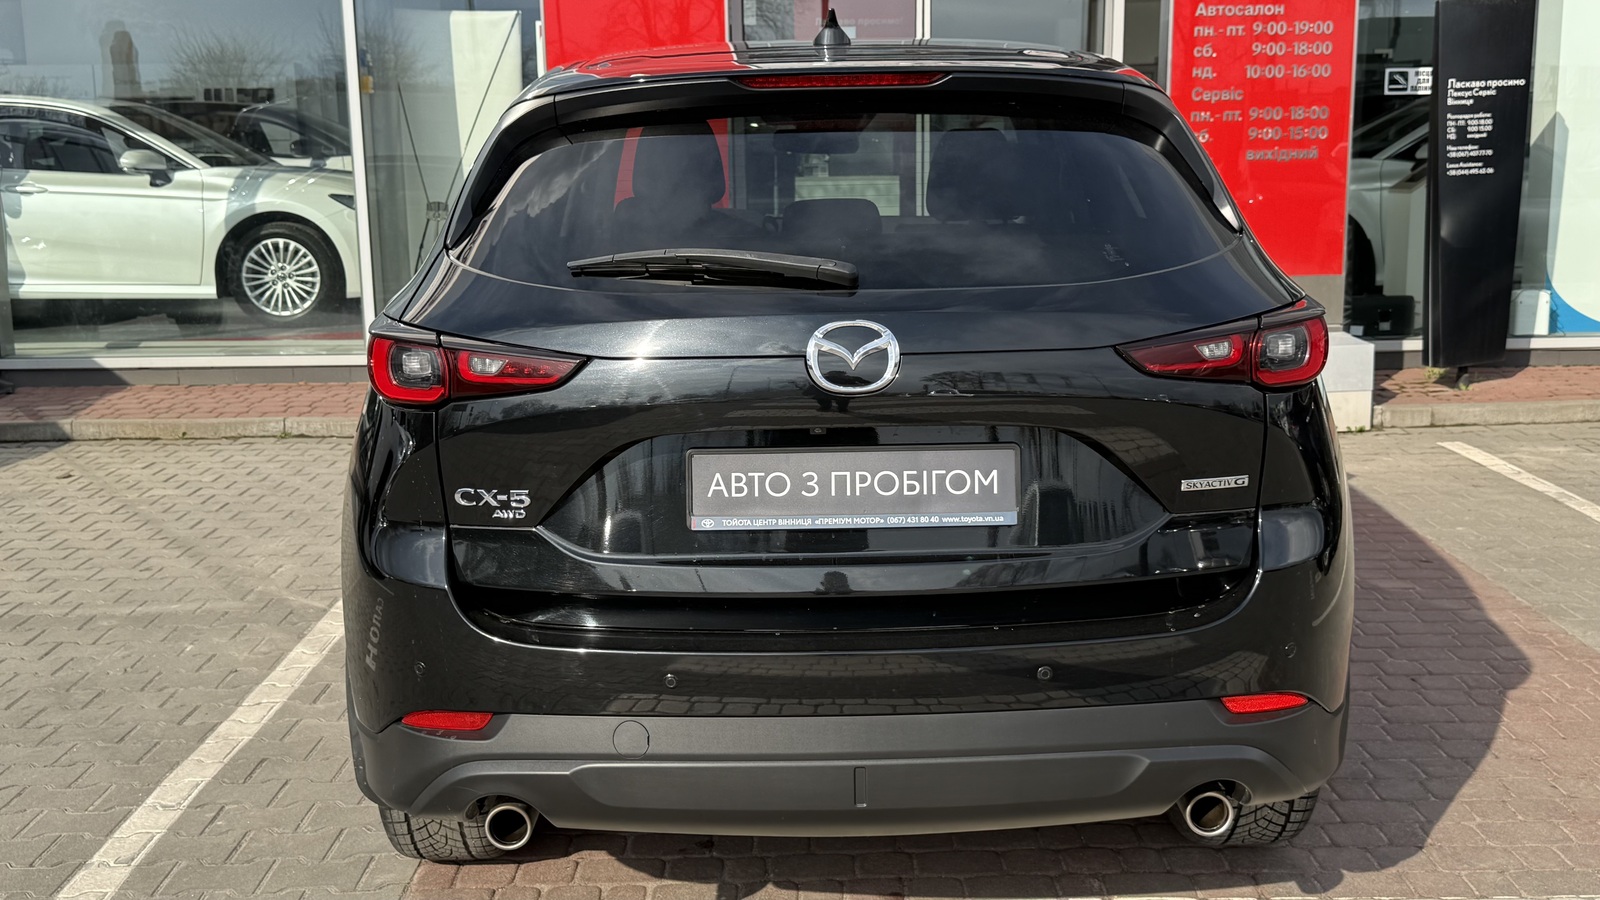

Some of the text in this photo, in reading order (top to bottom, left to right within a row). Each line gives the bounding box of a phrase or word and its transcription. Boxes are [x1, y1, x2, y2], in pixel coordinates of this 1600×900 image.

[1195, 3, 1285, 17] Автосалон
[1252, 21, 1334, 36] 9:00-19:00
[1193, 42, 1333, 58] сб. 9:00-18:00
[1192, 64, 1332, 80] нд. 10:00-16:00
[1447, 78, 1526, 89] Ласкаво просимо
[1191, 86, 1244, 104] Сервіс
[1447, 88, 1497, 98] Лексус Сервіс
[1249, 106, 1329, 120] 9:00-18:00
[1194, 126, 1328, 143] б. 9:00-15:00
[1246, 146, 1319, 162] вихідний
[707, 469, 998, 498] АВТО З ПРОБІГОМ
[454, 487, 531, 508] CX-5
[492, 509, 527, 519] AWD
[722, 515, 1004, 527] ТОЙОТА ЦЕНТР ВІННИЦЯ «ПРЕМІУМ МОТОР» (067) 431 80 40 www.toyota.vn.ua
